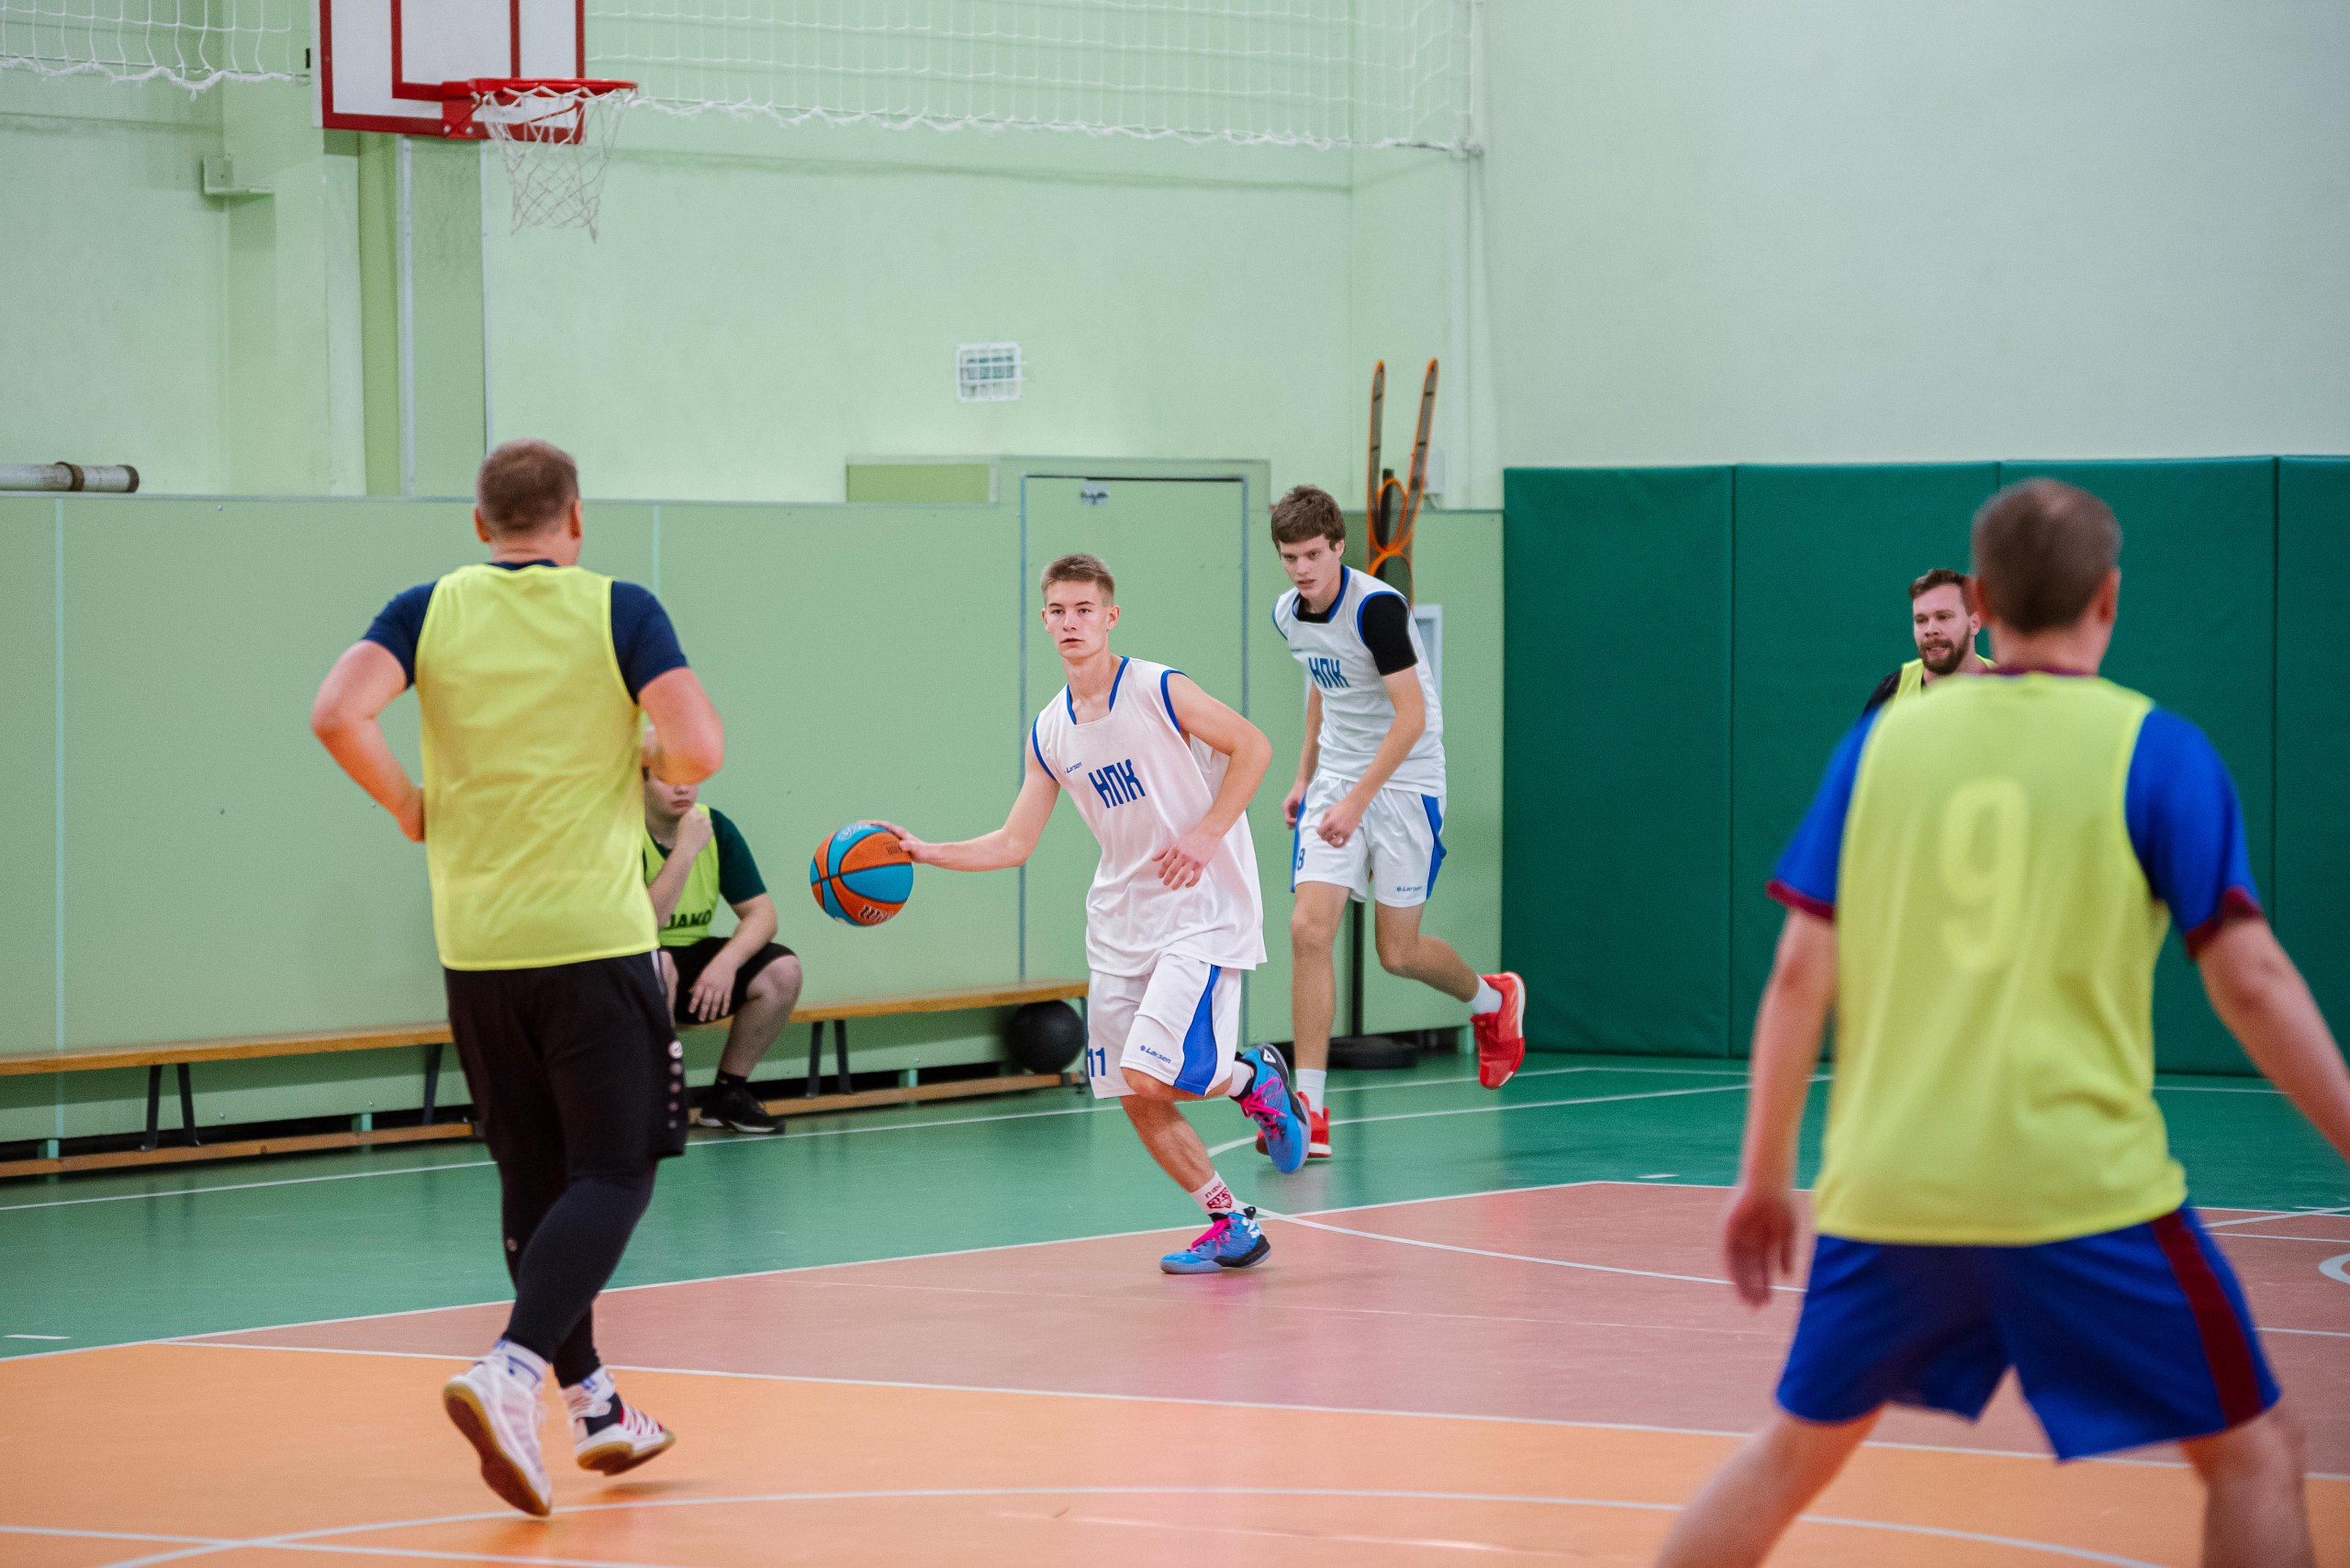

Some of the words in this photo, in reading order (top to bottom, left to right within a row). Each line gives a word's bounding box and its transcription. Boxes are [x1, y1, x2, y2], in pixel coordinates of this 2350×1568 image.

[1308, 656, 1351, 689] НПК
[1088, 758, 1147, 809] НПК
[1939, 779, 2027, 970] 9
[1088, 1047, 1105, 1077] 11
[1146, 1047, 1171, 1064] Larsen
